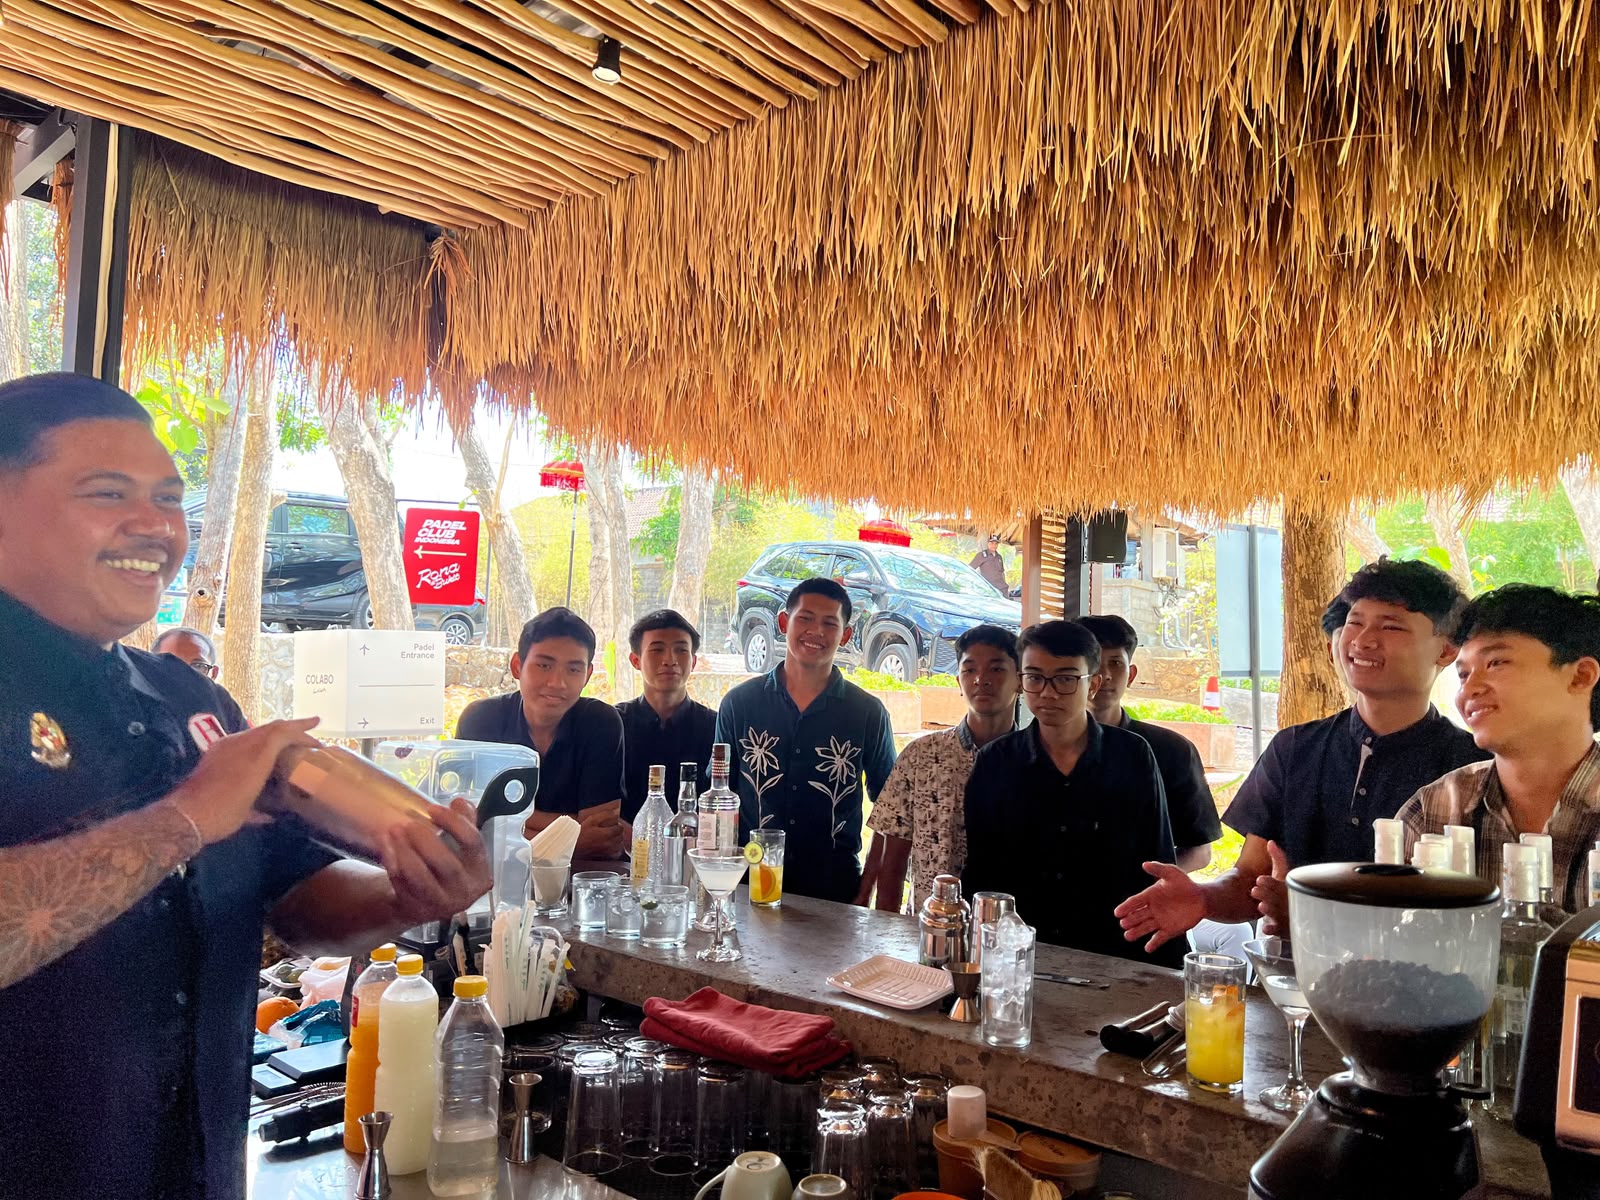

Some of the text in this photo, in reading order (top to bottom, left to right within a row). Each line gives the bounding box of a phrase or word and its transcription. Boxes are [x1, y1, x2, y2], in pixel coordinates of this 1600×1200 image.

[422, 519, 467, 530] PADEL
[417, 529, 457, 538] CLUB
[414, 537, 460, 545] INDONESIA
[414, 643, 435, 651] Padel
[400, 651, 435, 659] Entrance
[305, 674, 334, 685] COLABO
